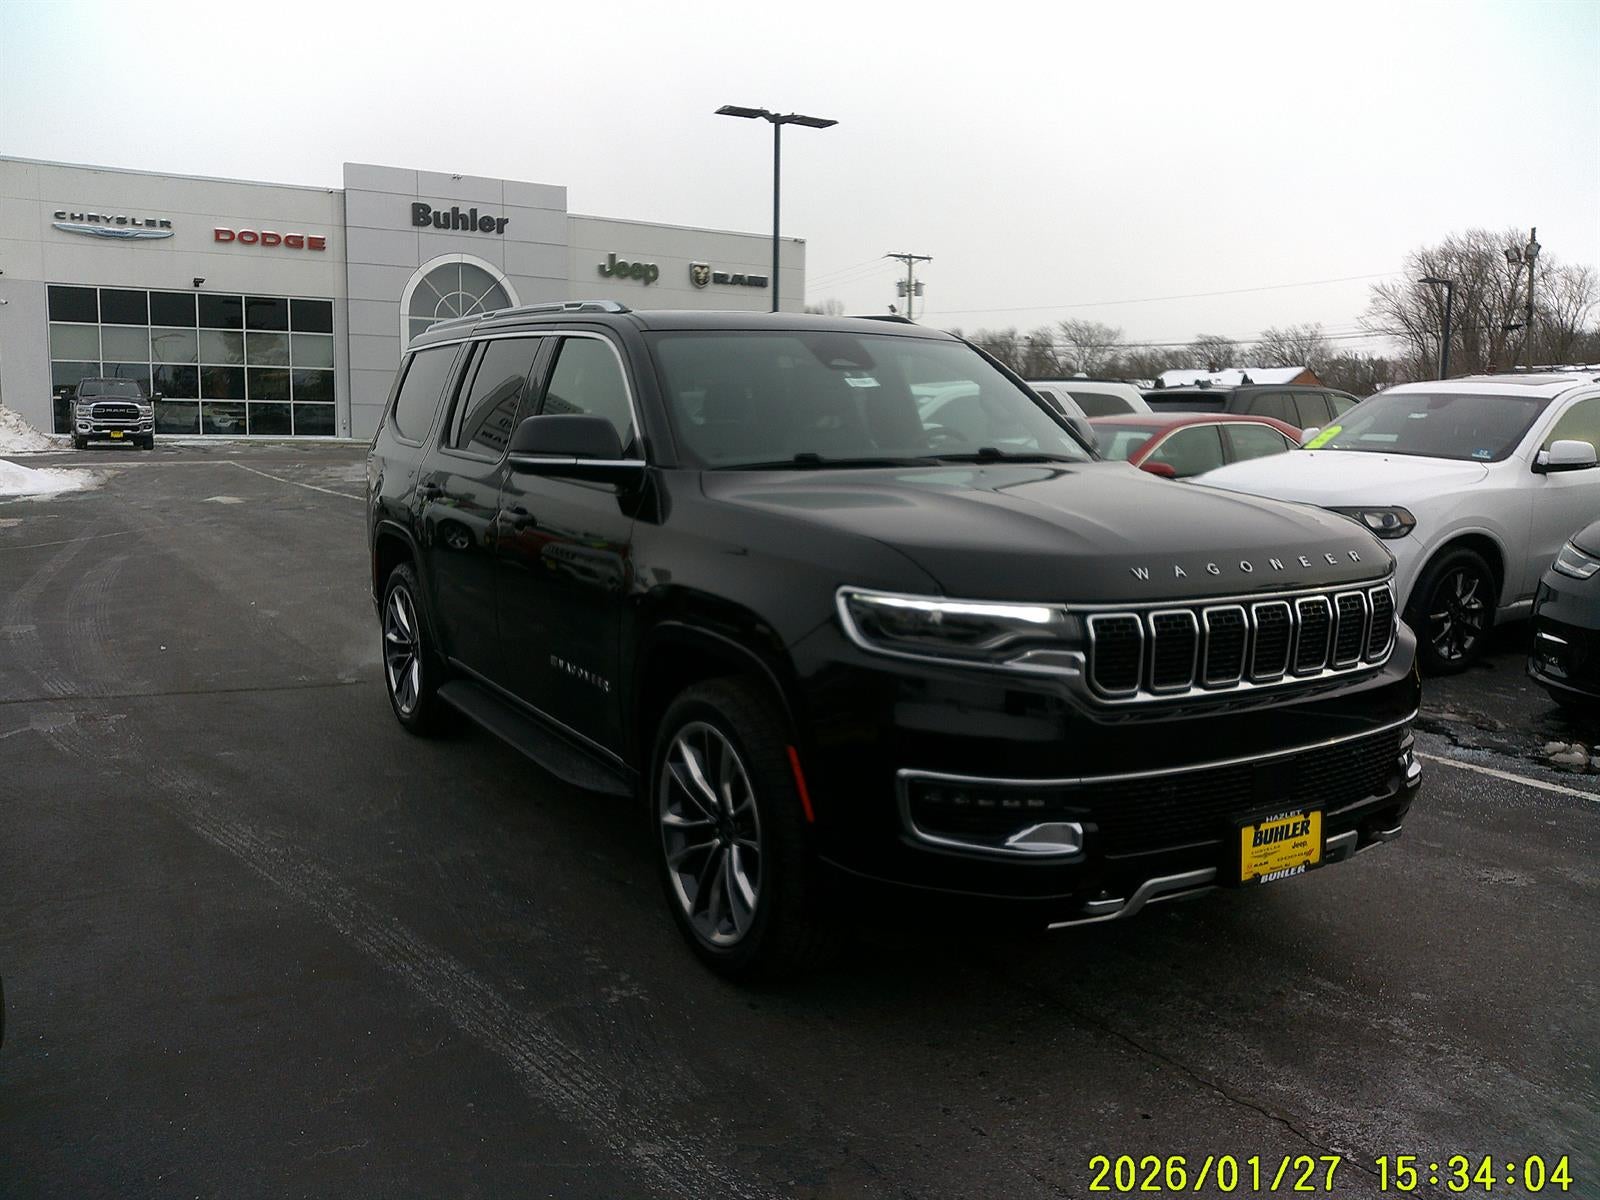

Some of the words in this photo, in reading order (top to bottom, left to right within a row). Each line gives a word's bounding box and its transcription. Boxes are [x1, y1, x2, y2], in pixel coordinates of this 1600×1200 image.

[54, 210, 172, 229] CHRYSLER
[411, 202, 509, 234] Buhler
[214, 228, 326, 251] DODGE
[598, 252, 659, 286] Jeep
[713, 271, 768, 288] RAM
[1130, 550, 1361, 581] WAGONEER
[1265, 810, 1302, 822] HAZLET
[1252, 820, 1310, 847] BUHLER
[1291, 840, 1308, 849] Jeep
[1260, 866, 1306, 884] BUHLER
